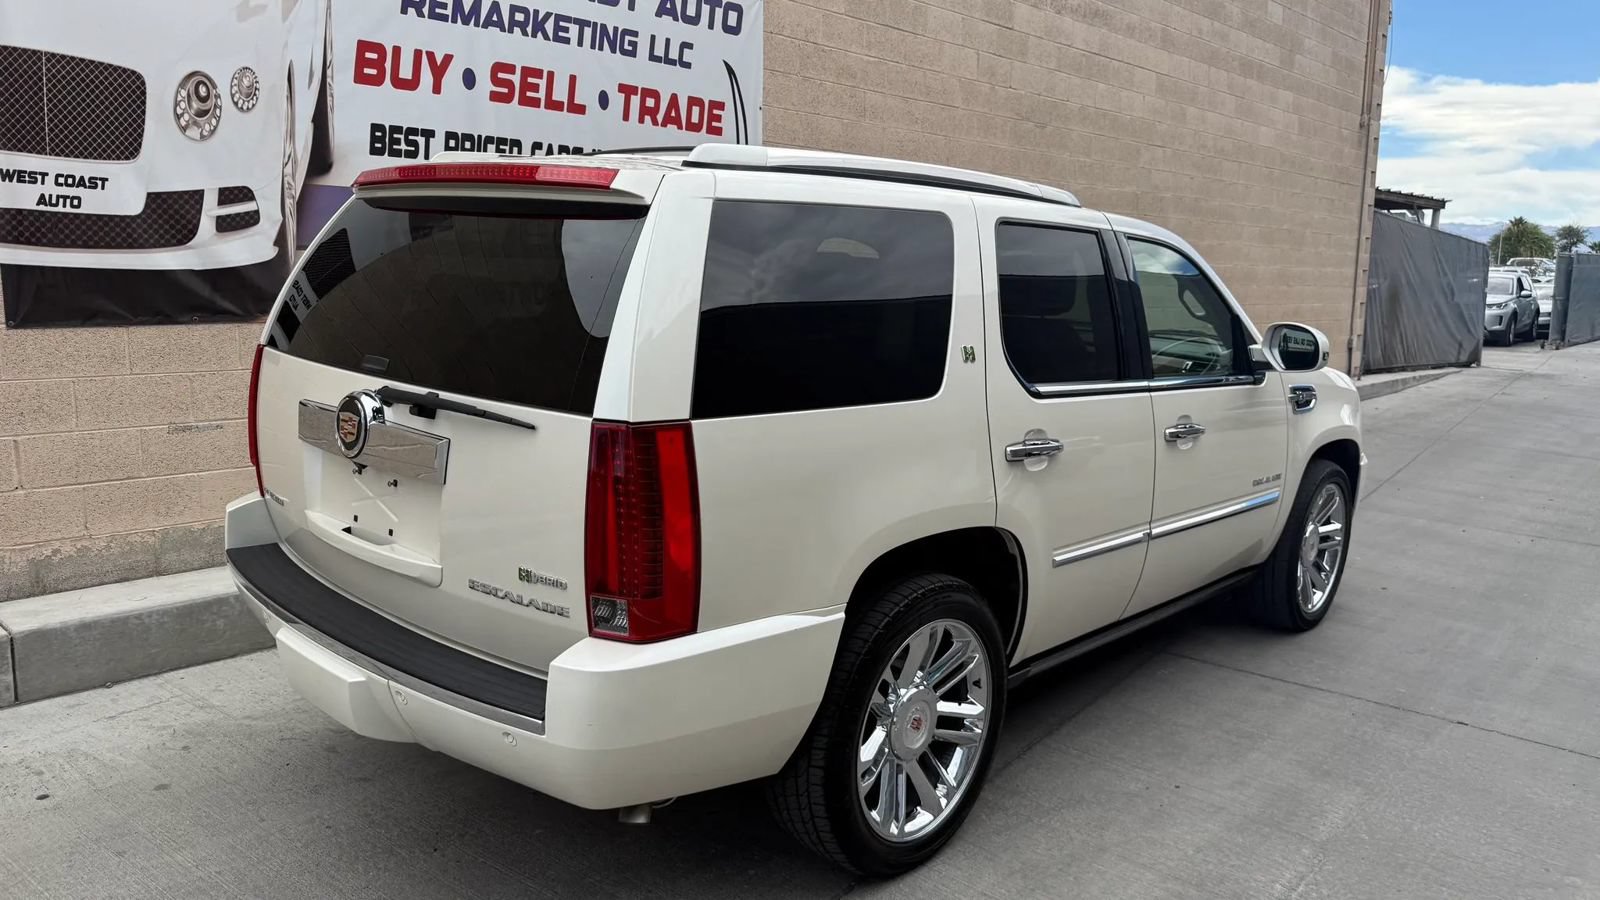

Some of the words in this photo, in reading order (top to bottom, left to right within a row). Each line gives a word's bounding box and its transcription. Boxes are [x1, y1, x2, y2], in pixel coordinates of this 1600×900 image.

[400, 0, 639, 58] REMARKETING
[648, 34, 694, 69] LLC
[654, 0, 744, 36] AUTO
[353, 39, 454, 95] BUY
[489, 61, 587, 115] SELL
[617, 82, 726, 136] TRADE
[369, 122, 436, 160] BEST
[0, 168, 49, 186] WEST
[54, 173, 109, 190] COAST
[36, 193, 82, 209] AUTO
[468, 579, 571, 618] ESCALADE
